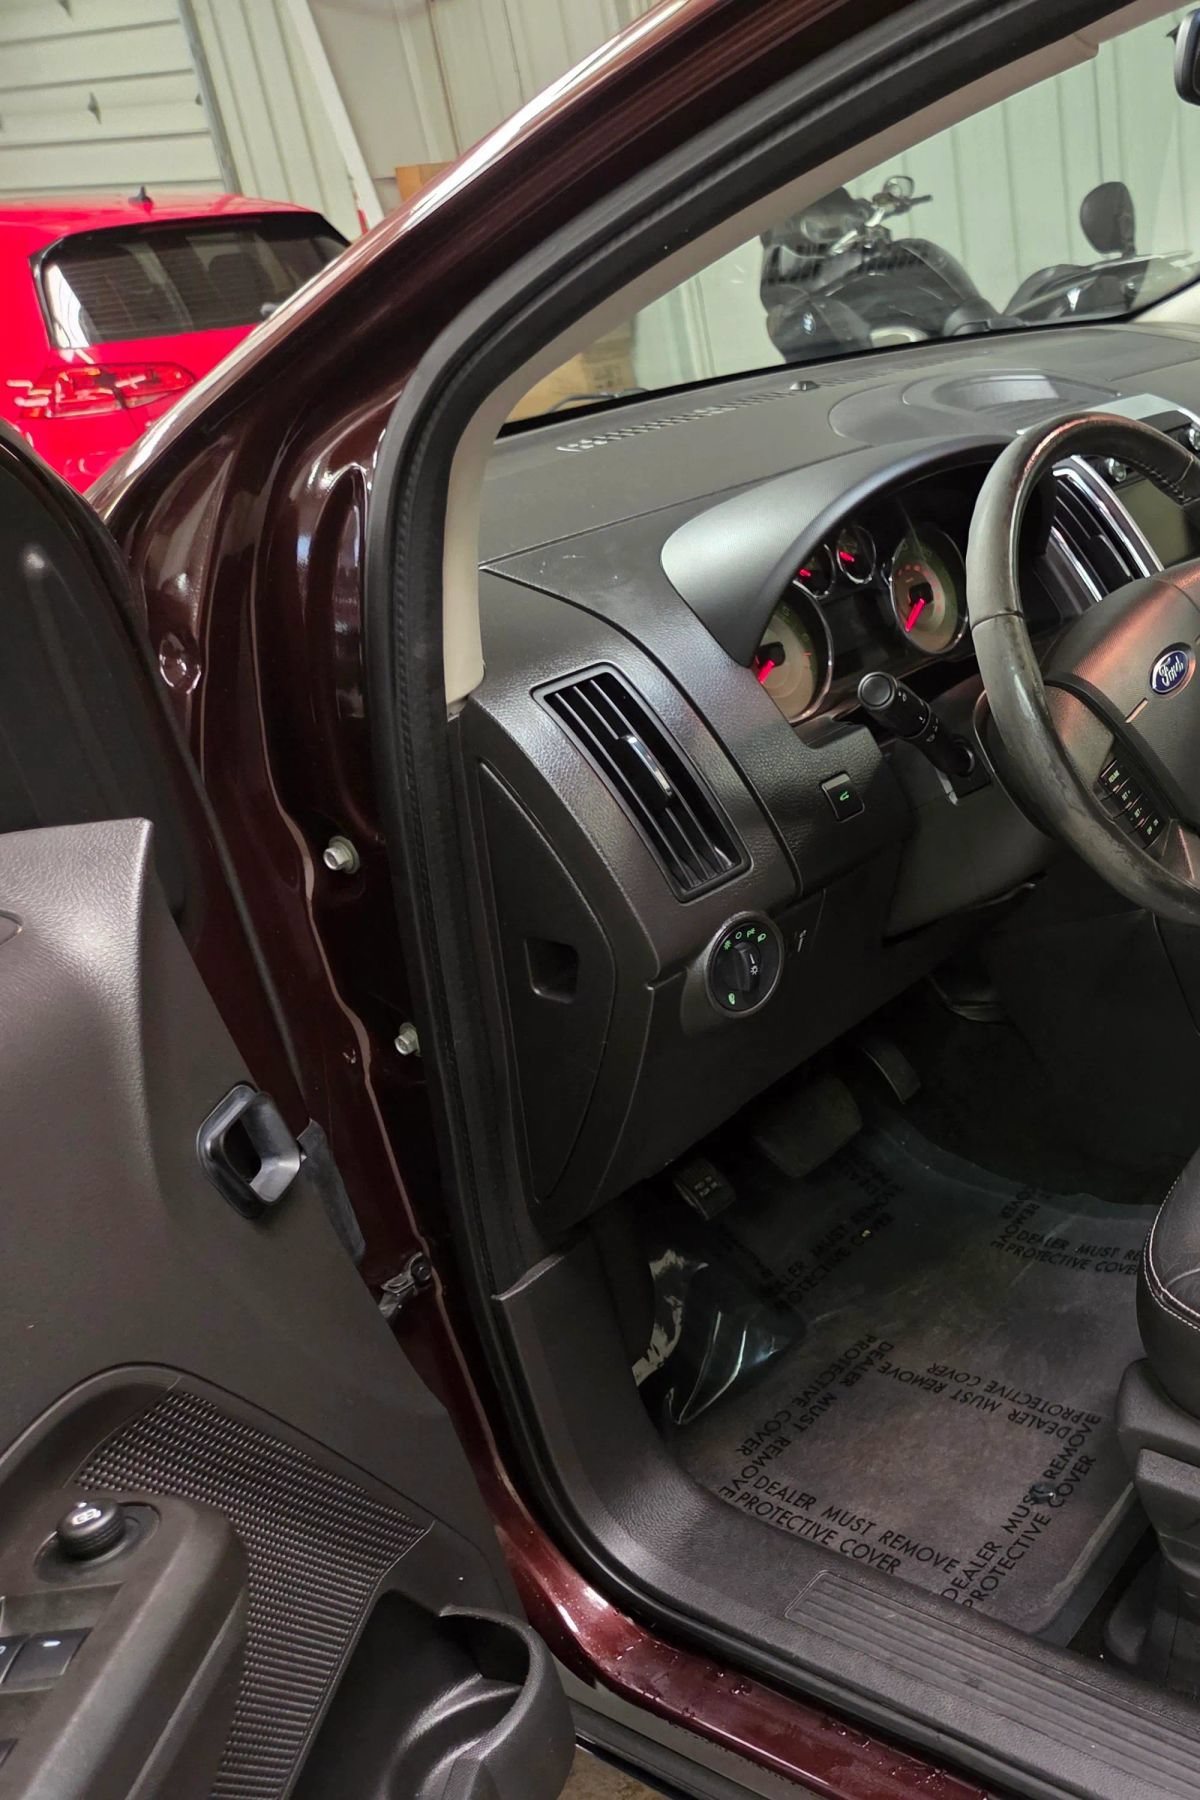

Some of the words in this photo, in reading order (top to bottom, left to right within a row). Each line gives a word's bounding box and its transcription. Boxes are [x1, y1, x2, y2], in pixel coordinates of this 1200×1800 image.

[1157, 655, 1184, 687] Ford
[1005, 1244, 1092, 1271] PROTECTIVE
[1094, 1260, 1137, 1275] COVE
[1016, 1230, 1071, 1251] DEALER
[1077, 1244, 1121, 1259] MUST
[791, 1333, 878, 1407] PROTECTIVE
[840, 1340, 894, 1387] DEALER
[877, 1361, 949, 1395] REMOVE
[926, 1362, 981, 1387] COVER
[793, 1392, 838, 1432] MUST
[949, 1389, 1004, 1413] MUST
[983, 1380, 1087, 1425] PROTECTIVE
[1007, 1407, 1071, 1439] DEALER
[735, 1409, 792, 1456] COVER
[718, 1436, 791, 1498] REMOVE
[753, 1475, 817, 1511] DEALER
[819, 1505, 877, 1535] MUST
[878, 1529, 961, 1575] REMOVE
[940, 1540, 1003, 1601] DEALER
[999, 1482, 1045, 1534] MUST
[1042, 1413, 1102, 1480] REMOVE
[737, 1492, 838, 1546] PROTECTIVE
[839, 1539, 901, 1575] COVER
[962, 1512, 1052, 1608] PROTECTIVE
[1047, 1454, 1097, 1508] COVER
